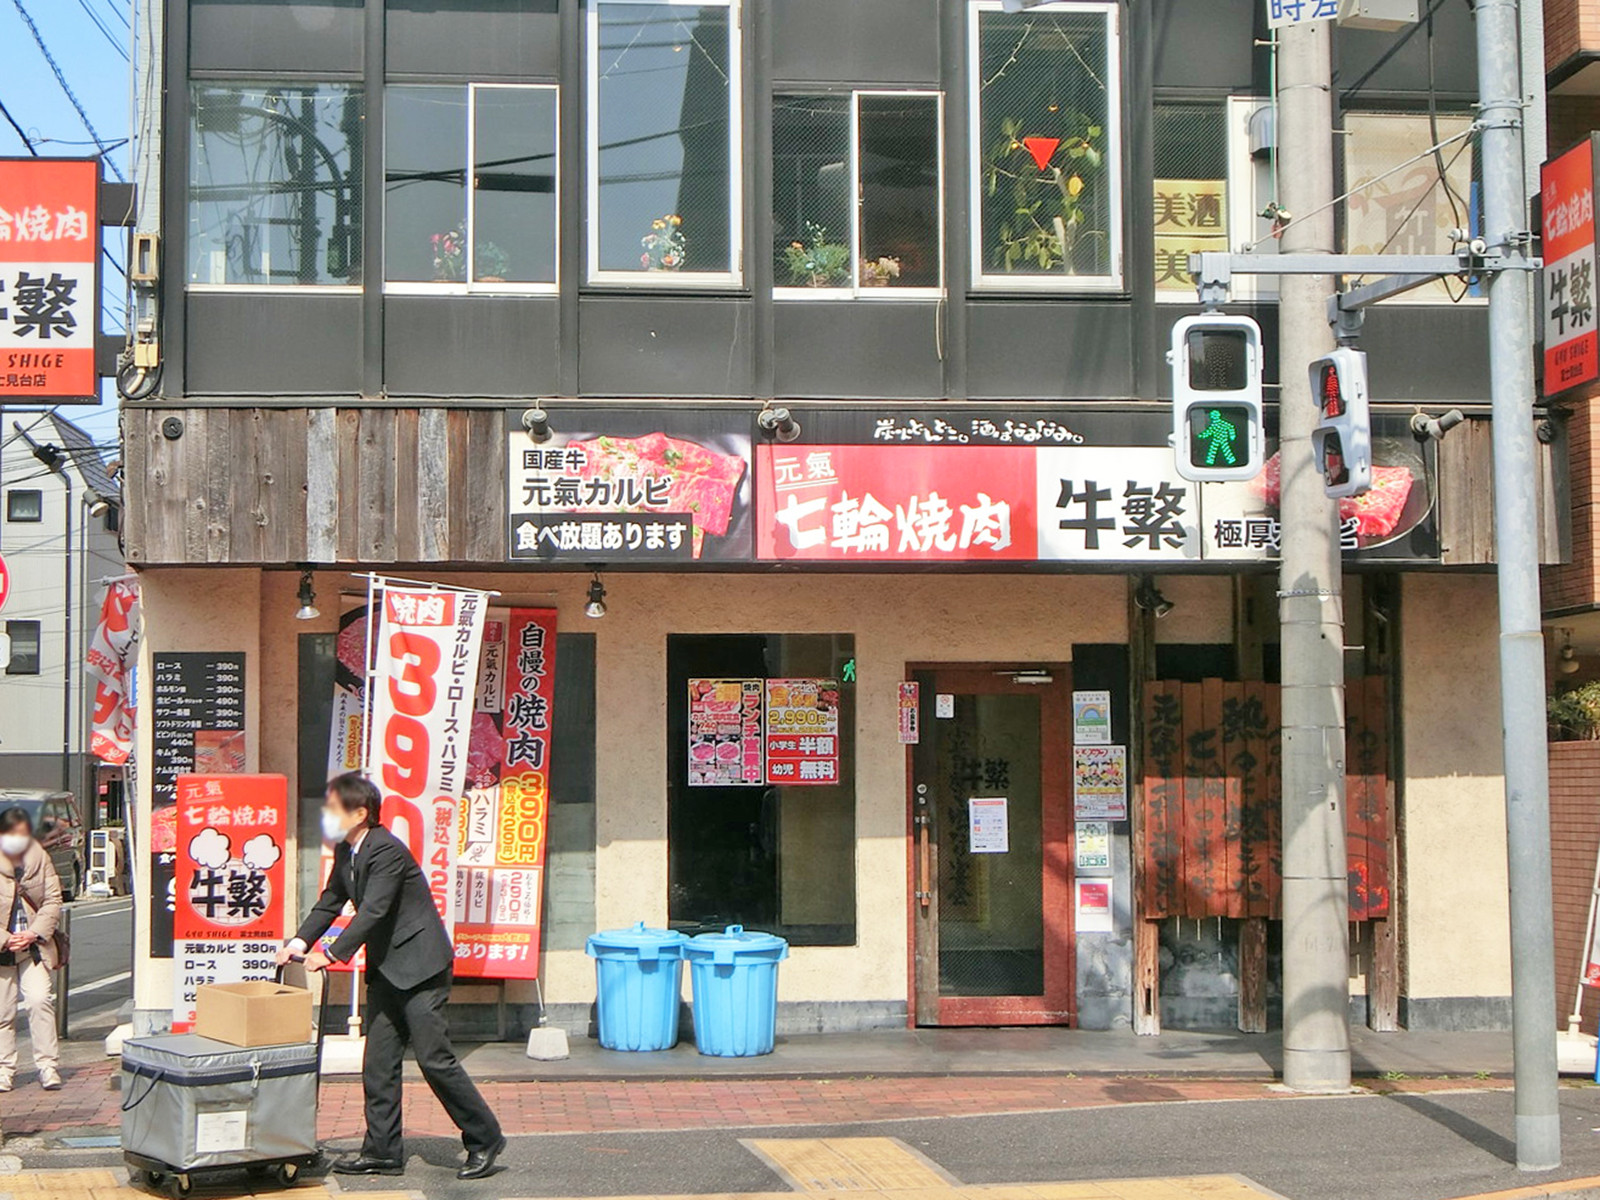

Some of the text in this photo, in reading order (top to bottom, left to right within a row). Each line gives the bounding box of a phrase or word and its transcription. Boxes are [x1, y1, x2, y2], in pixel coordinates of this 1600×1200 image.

[1271, 0, 1337, 21] 時
[1154, 191, 1222, 228] 美酒
[0, 272, 77, 339] 繁
[1550, 259, 1592, 335] 牛繁
[8, 353, 64, 368] SHIGE
[523, 450, 585, 470] 国産牛
[775, 452, 835, 484] 元氣
[523, 477, 672, 507] 元氣カルビ
[775, 490, 1012, 553] 七輪焼肉
[1055, 478, 1187, 550] 牛繁
[516, 521, 687, 550] 食べ放題あります
[1214, 516, 1359, 549] 極厚ビ
[391, 594, 445, 625] 焼肉
[508, 623, 548, 769] 自慢の焼肉
[184, 805, 278, 827] 七輪焼肉
[473, 795, 490, 836] ハラミ
[190, 869, 266, 918] 牛繁
[184, 943, 277, 954] 元氣カルビ 390円
[185, 960, 276, 969] ロース 390円
